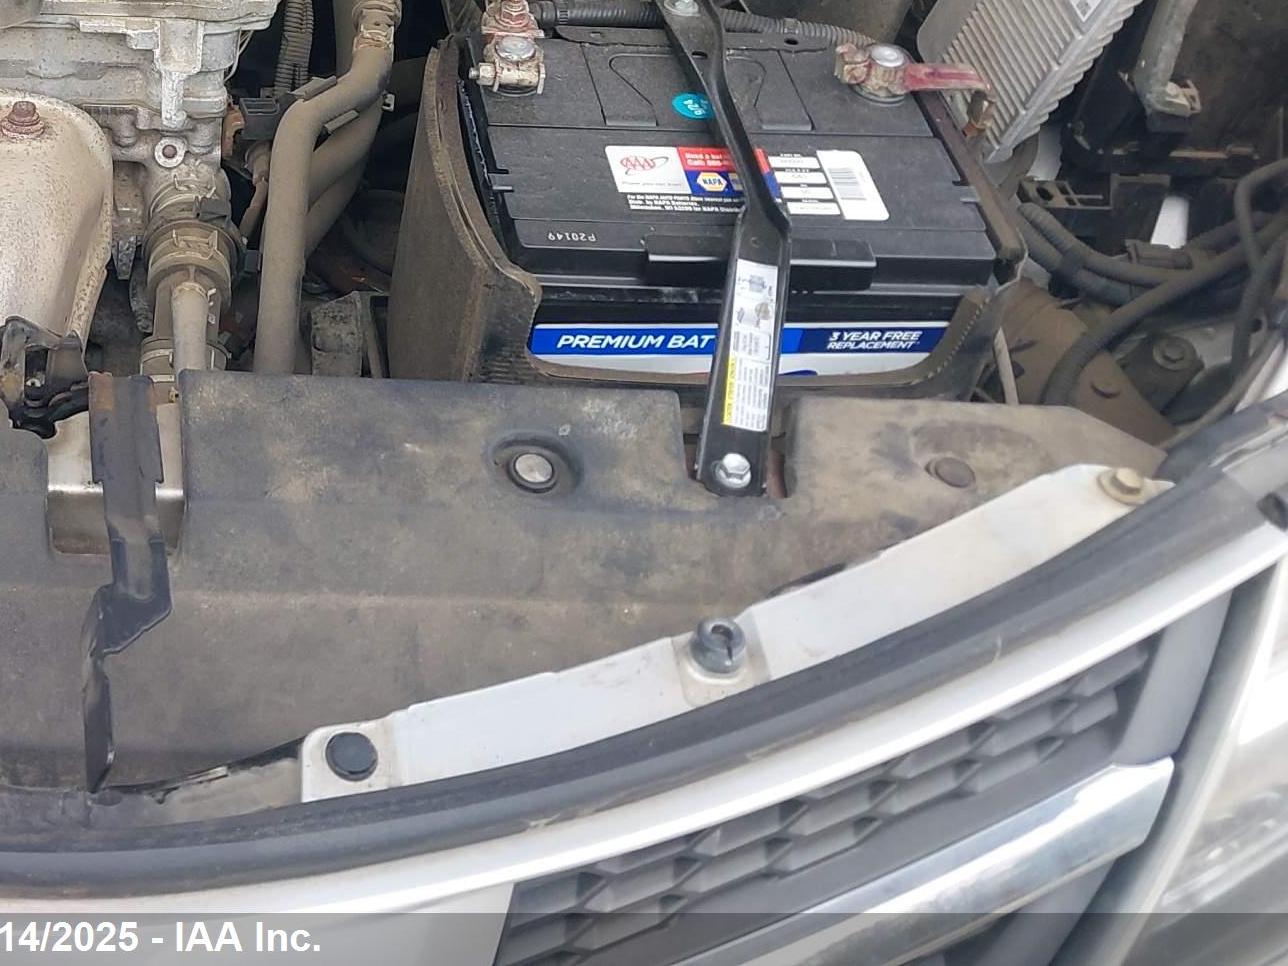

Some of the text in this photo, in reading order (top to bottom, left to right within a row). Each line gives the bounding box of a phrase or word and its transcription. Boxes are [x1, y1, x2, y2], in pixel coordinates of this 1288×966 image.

[621, 156, 655, 170] AAA
[702, 178, 724, 186] NAPA
[547, 232, 597, 242] P20149
[829, 331, 923, 341] 3 YEAR FREE
[557, 335, 665, 349] PREMIUM
